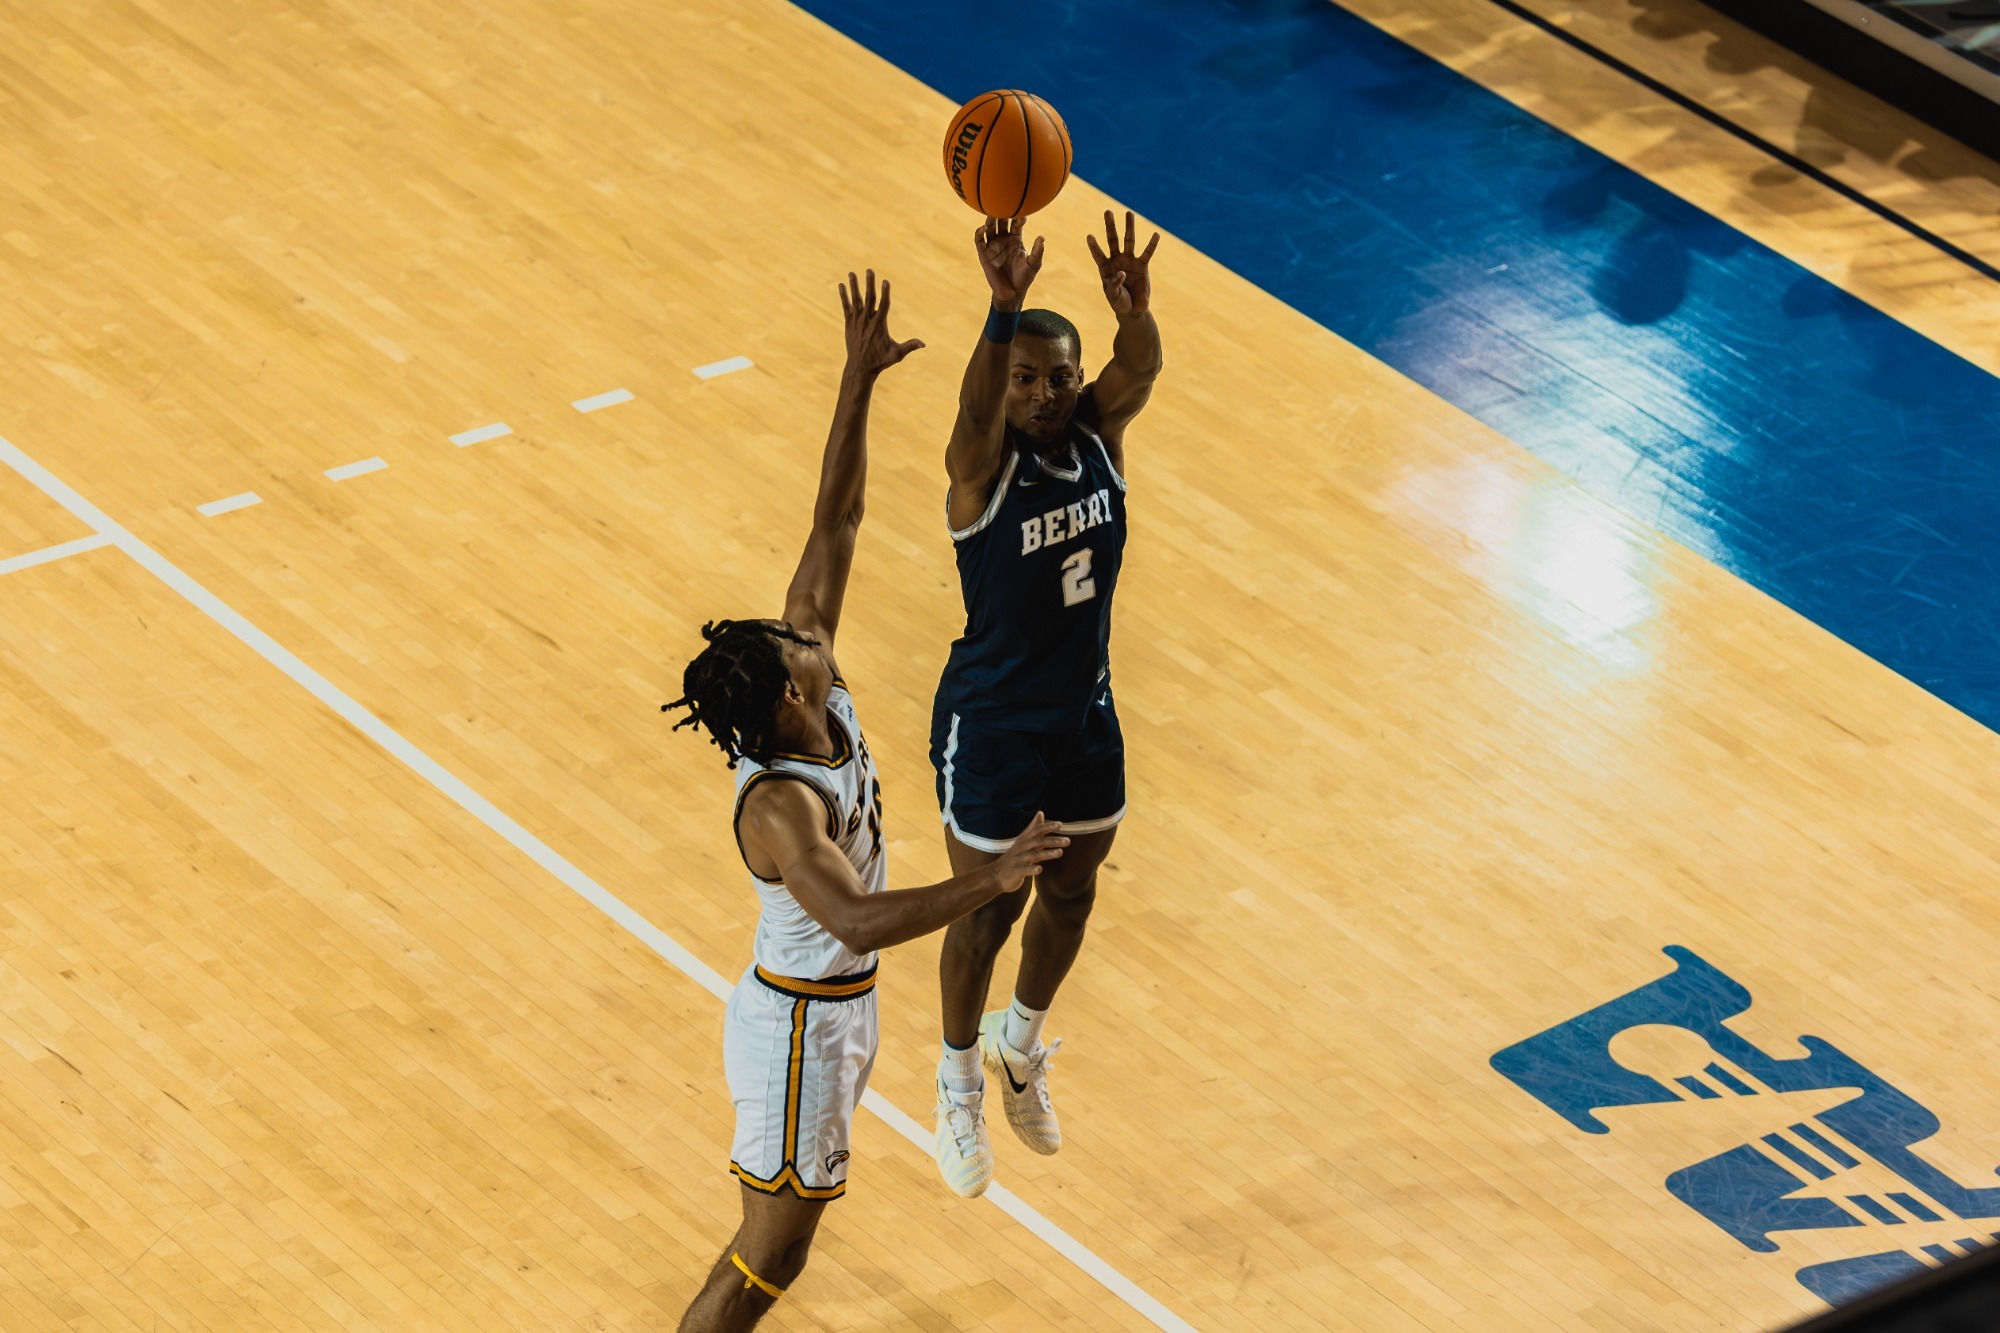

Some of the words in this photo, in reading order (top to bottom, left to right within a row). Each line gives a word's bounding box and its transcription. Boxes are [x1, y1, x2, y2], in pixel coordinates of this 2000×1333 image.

[951, 122, 984, 200] Wilson
[1021, 489, 1112, 557] BERRY
[1061, 547, 1096, 607] 2
